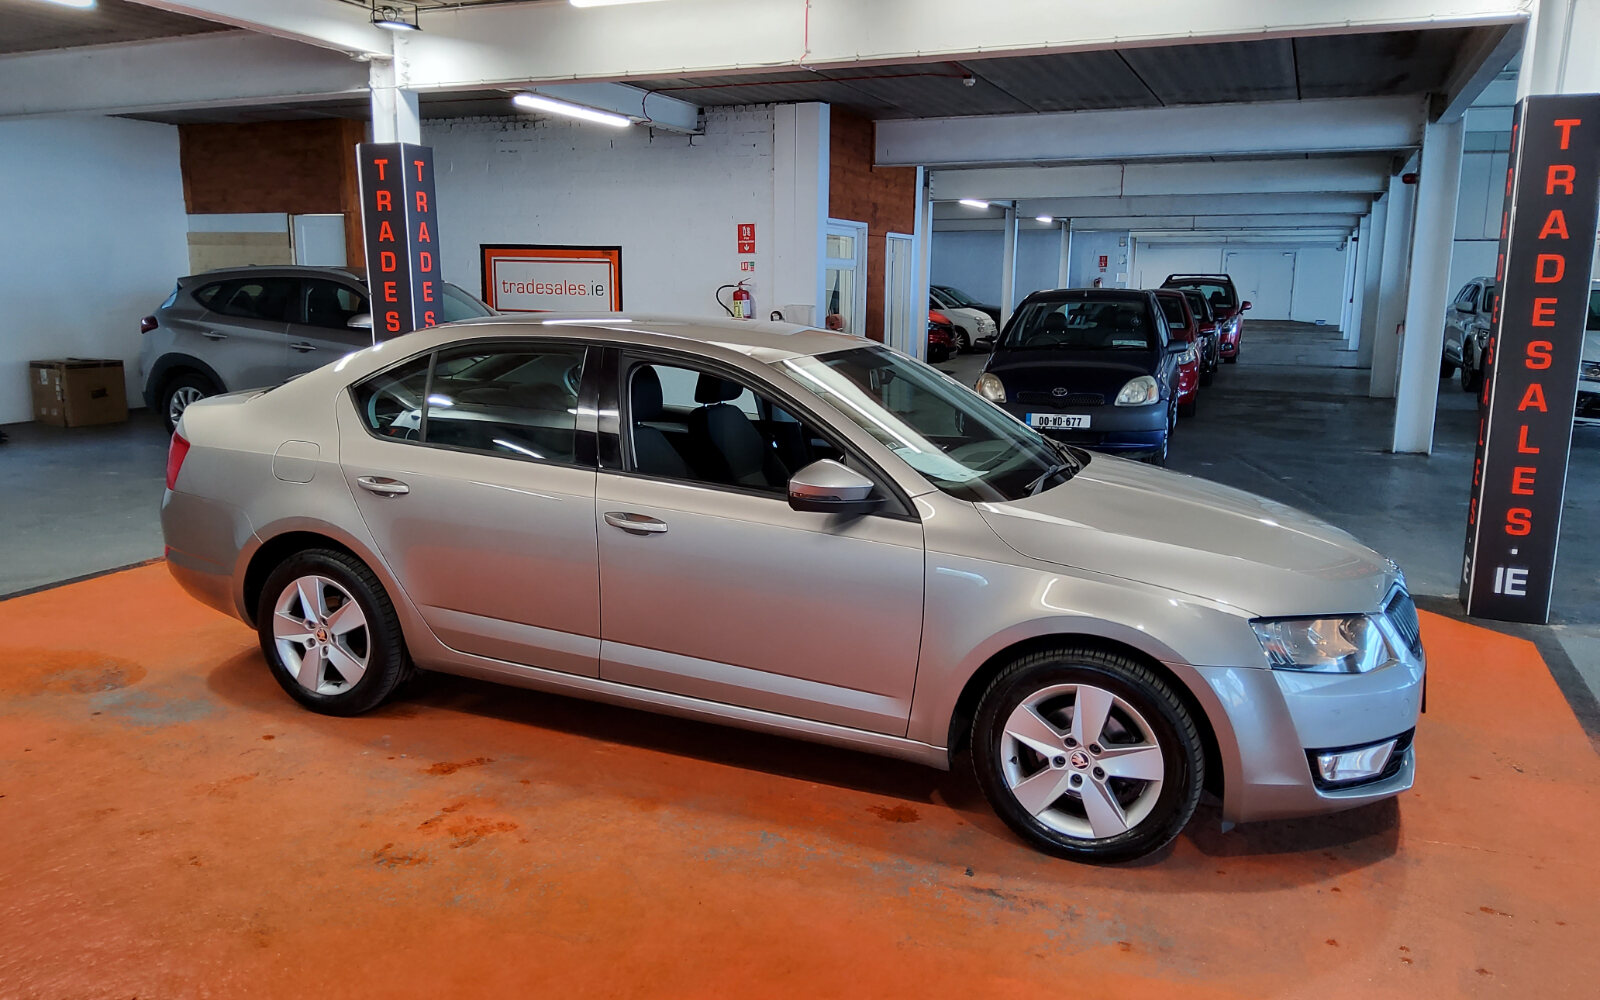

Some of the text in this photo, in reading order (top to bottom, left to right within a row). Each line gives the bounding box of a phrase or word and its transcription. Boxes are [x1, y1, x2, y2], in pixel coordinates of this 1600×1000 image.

[374, 158, 400, 332] TRADES
[502, 279, 604, 297] tradesales.ie
[1038, 416, 1082, 427] 00-WD-677
